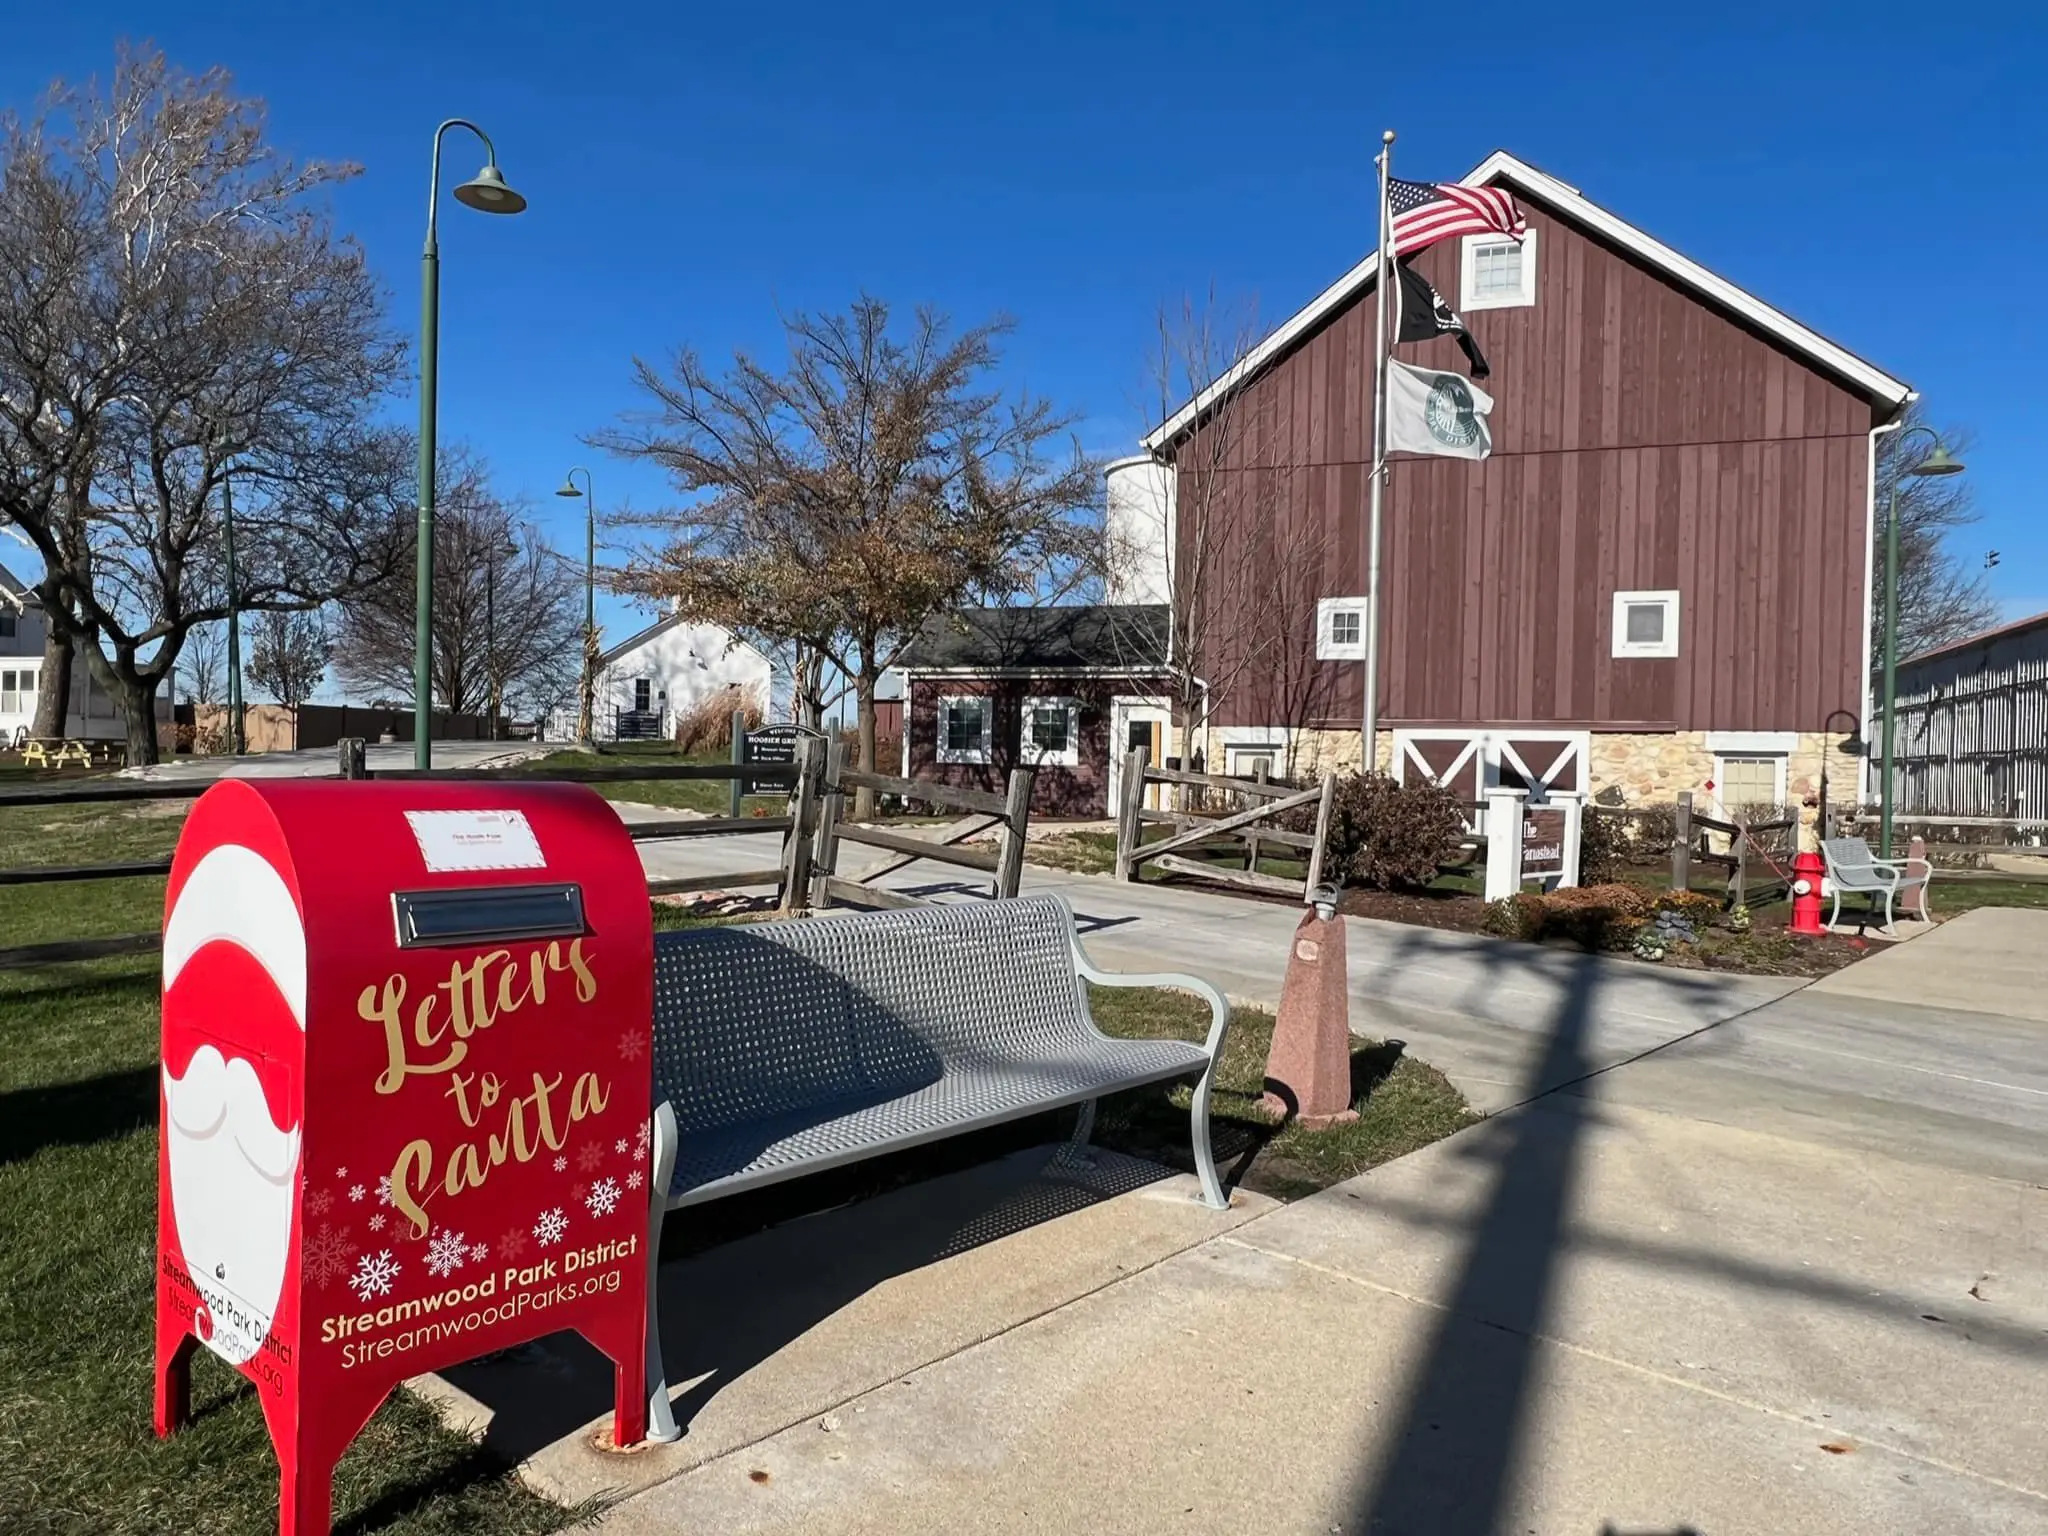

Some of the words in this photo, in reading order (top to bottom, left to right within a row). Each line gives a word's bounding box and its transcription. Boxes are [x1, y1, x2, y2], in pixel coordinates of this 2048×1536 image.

[748, 736, 780, 744] HOOSIER
[1523, 821, 1537, 838] The
[357, 937, 597, 1095] Letters
[444, 1070, 507, 1128] to
[391, 1070, 612, 1241] Santa
[162, 1254, 224, 1316] Streamwood
[226, 1298, 252, 1336] Park
[253, 1318, 293, 1368] District
[320, 1272, 497, 1344] Streamwood
[503, 1257, 557, 1291] Park
[563, 1233, 638, 1274] District
[340, 1269, 622, 1370] StreamwoodParks.org
